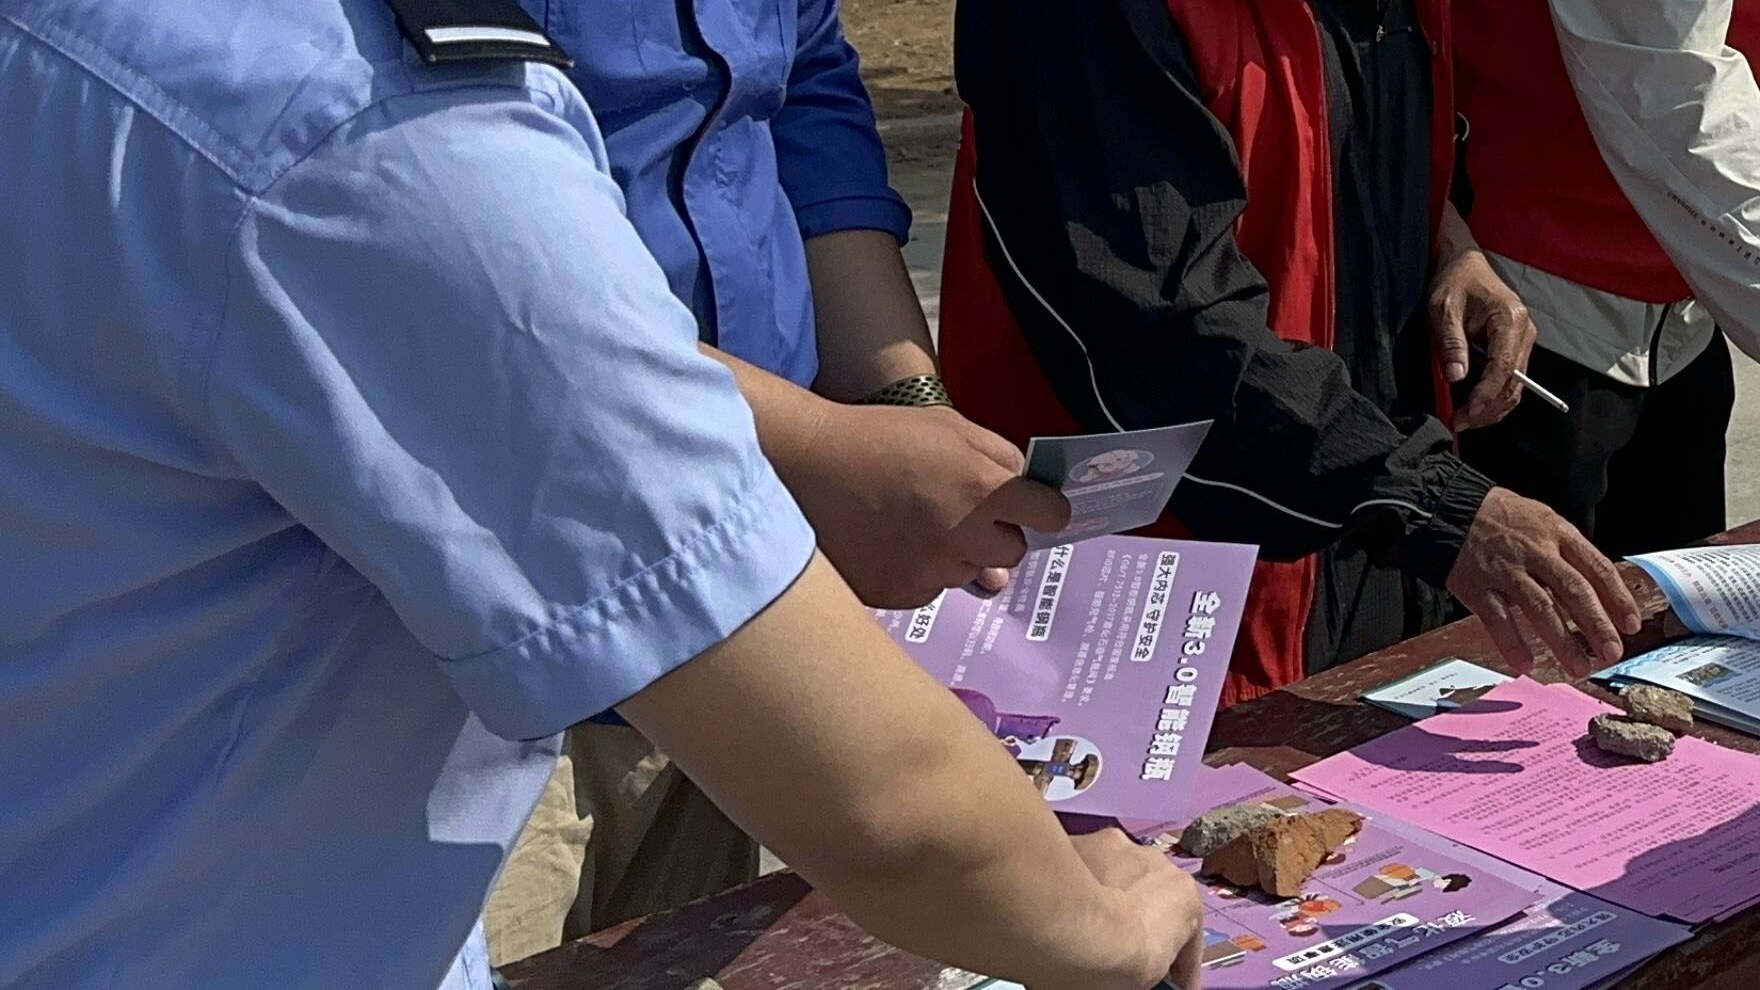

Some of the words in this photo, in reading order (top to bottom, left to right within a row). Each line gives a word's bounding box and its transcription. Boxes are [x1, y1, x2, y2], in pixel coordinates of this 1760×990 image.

[1032, 544, 1072, 638] 什么是智能钢瓶
[1150, 552, 1179, 605] 强大内芯
[1133, 606, 1161, 660] 守护安全
[1140, 590, 1222, 783] 全新3.0智能钢瓶
